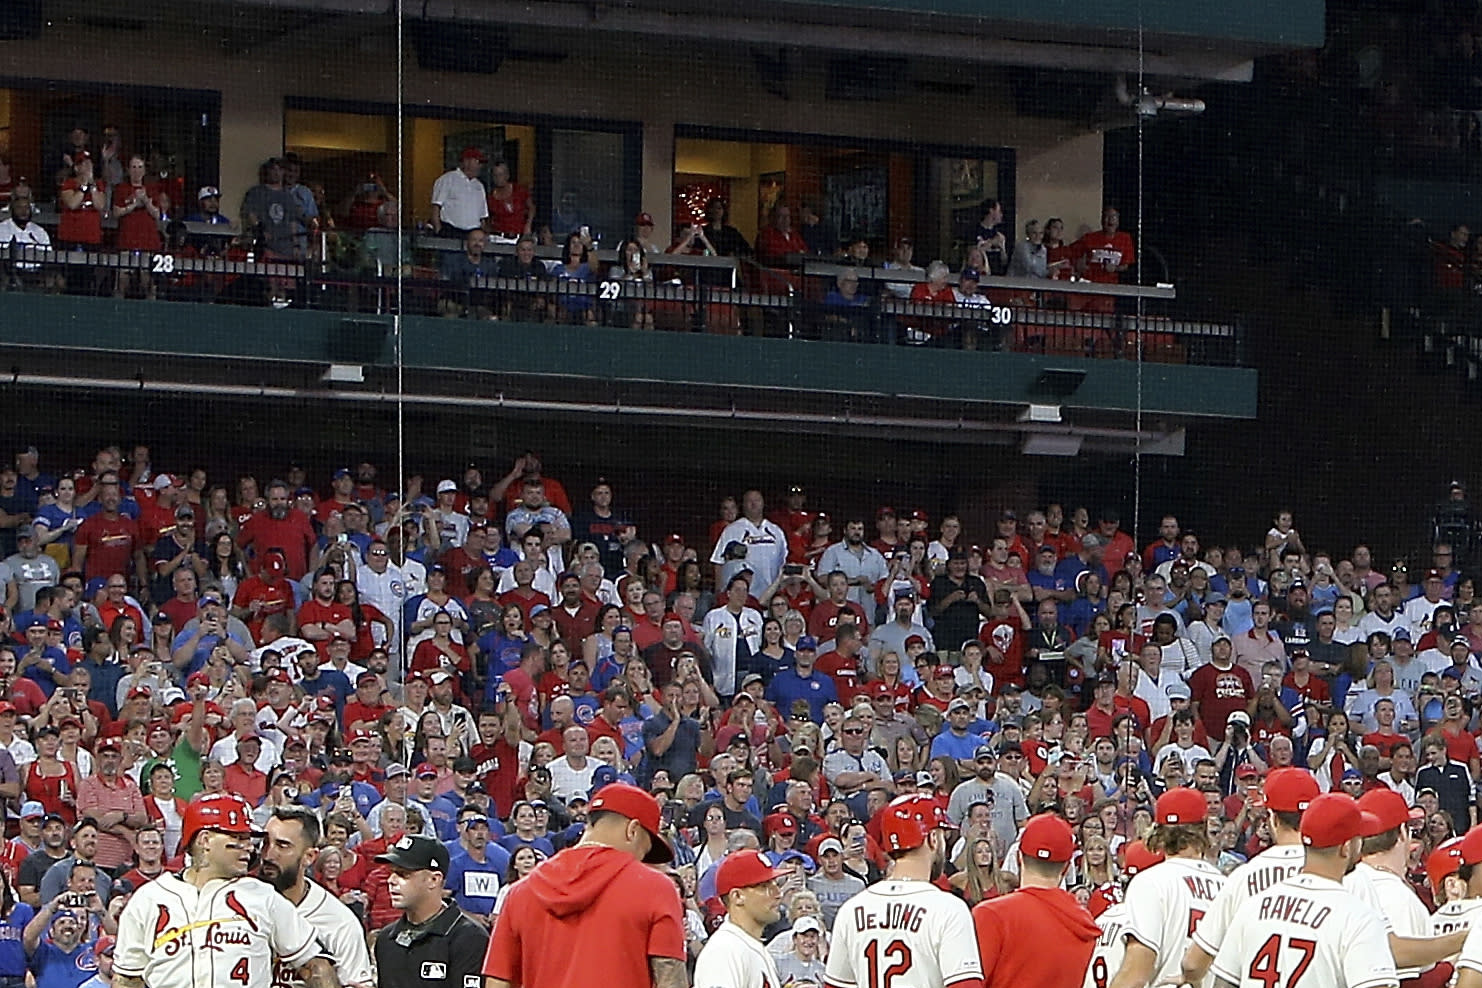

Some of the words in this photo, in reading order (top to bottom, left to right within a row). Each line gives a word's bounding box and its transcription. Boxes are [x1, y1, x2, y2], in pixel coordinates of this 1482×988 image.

[153, 255, 174, 273] 28
[600, 282, 621, 299] 29
[991, 308, 1012, 324] 30
[475, 878, 489, 892] W
[1259, 895, 1332, 929] RAVELO
[200, 922, 251, 952] Louis
[230, 957, 249, 986] 4
